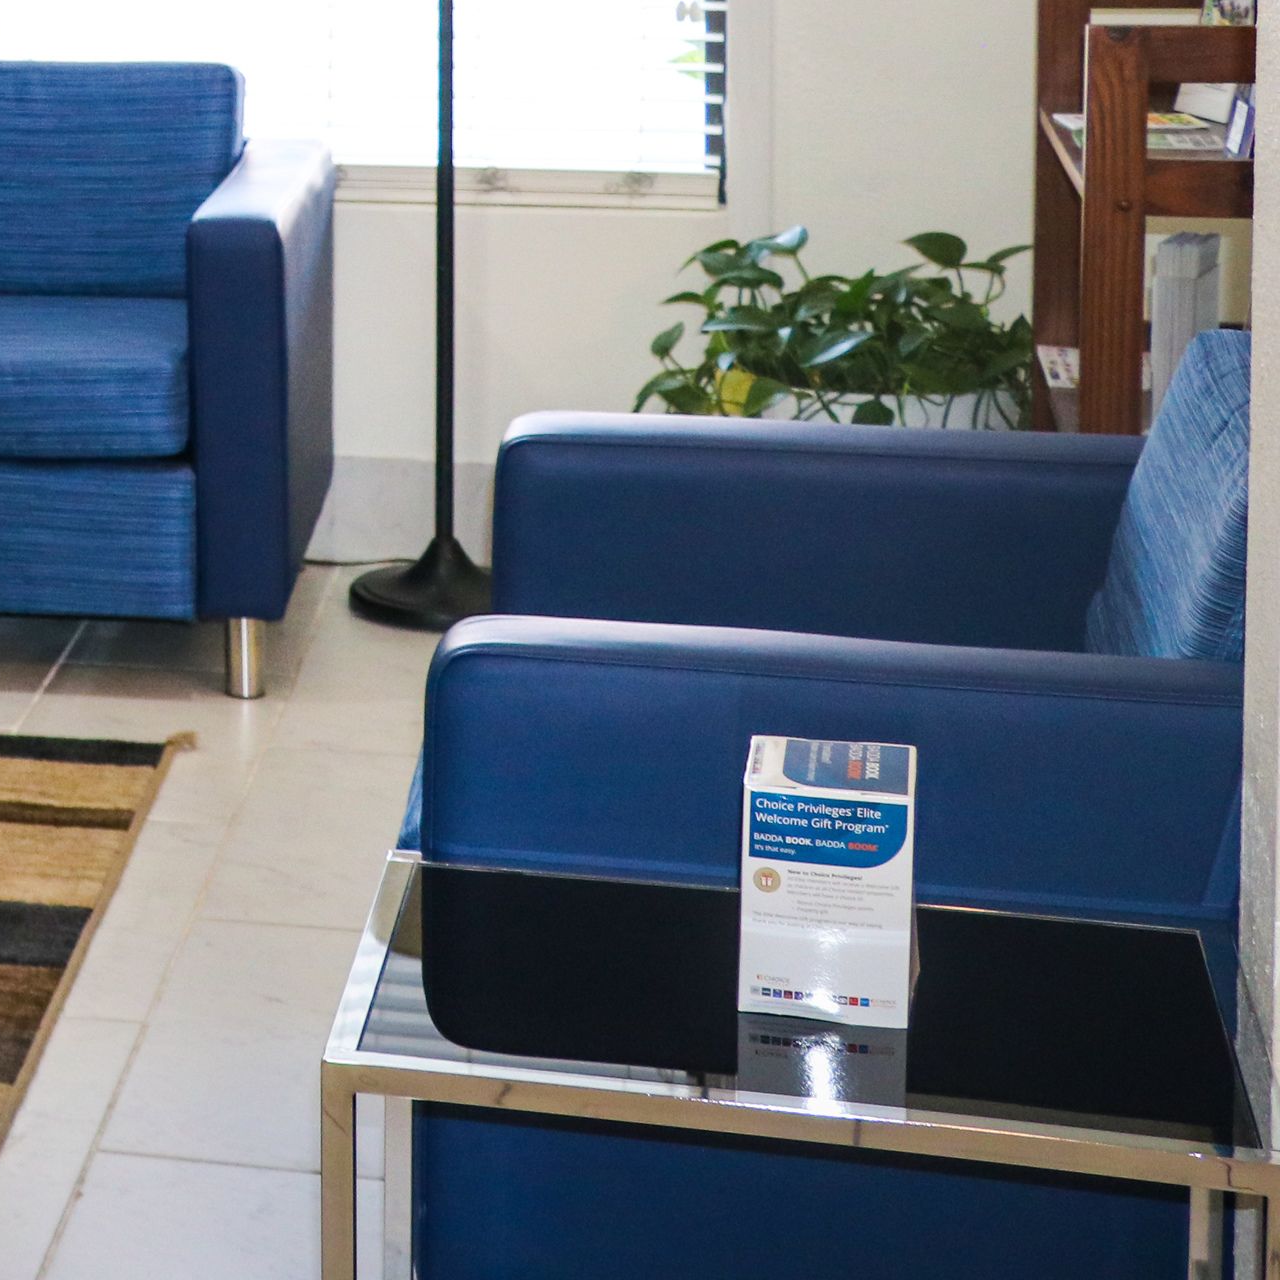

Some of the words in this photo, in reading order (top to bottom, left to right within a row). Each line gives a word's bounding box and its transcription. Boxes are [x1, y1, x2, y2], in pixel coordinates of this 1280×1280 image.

[755, 798, 794, 812] Choice
[857, 807, 882, 819] Elite
[755, 811, 808, 827] Welcome
[811, 818, 832, 829] Gift
[754, 832, 783, 843] BADDA
[815, 839, 846, 849] BADDA
